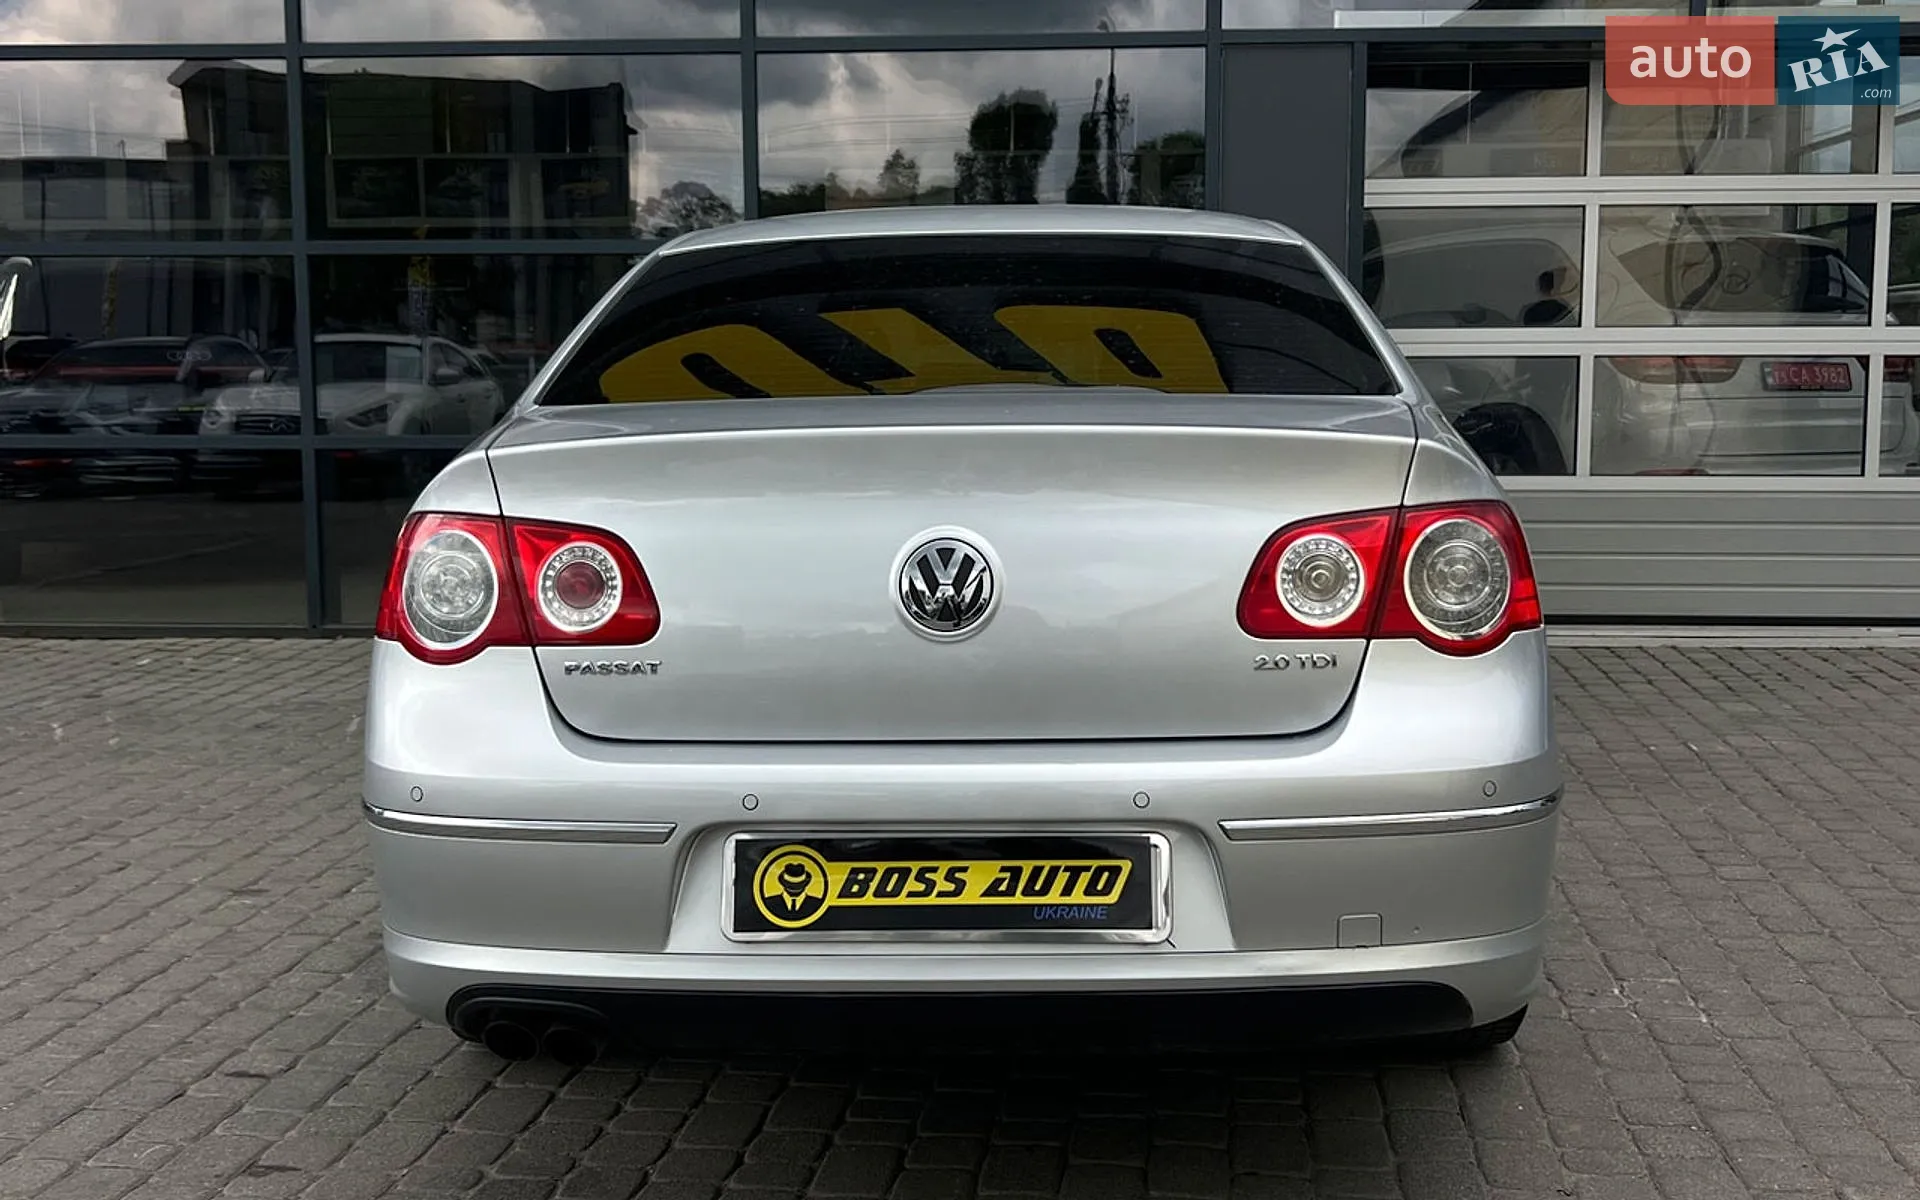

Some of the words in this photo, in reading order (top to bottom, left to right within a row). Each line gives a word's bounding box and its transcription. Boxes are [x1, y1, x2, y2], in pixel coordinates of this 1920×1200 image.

[564, 661, 662, 675] PASSAT
[836, 866, 970, 898] BOSS
[980, 864, 1124, 898] AUTO
[1033, 906, 1108, 920] UKRAINE
